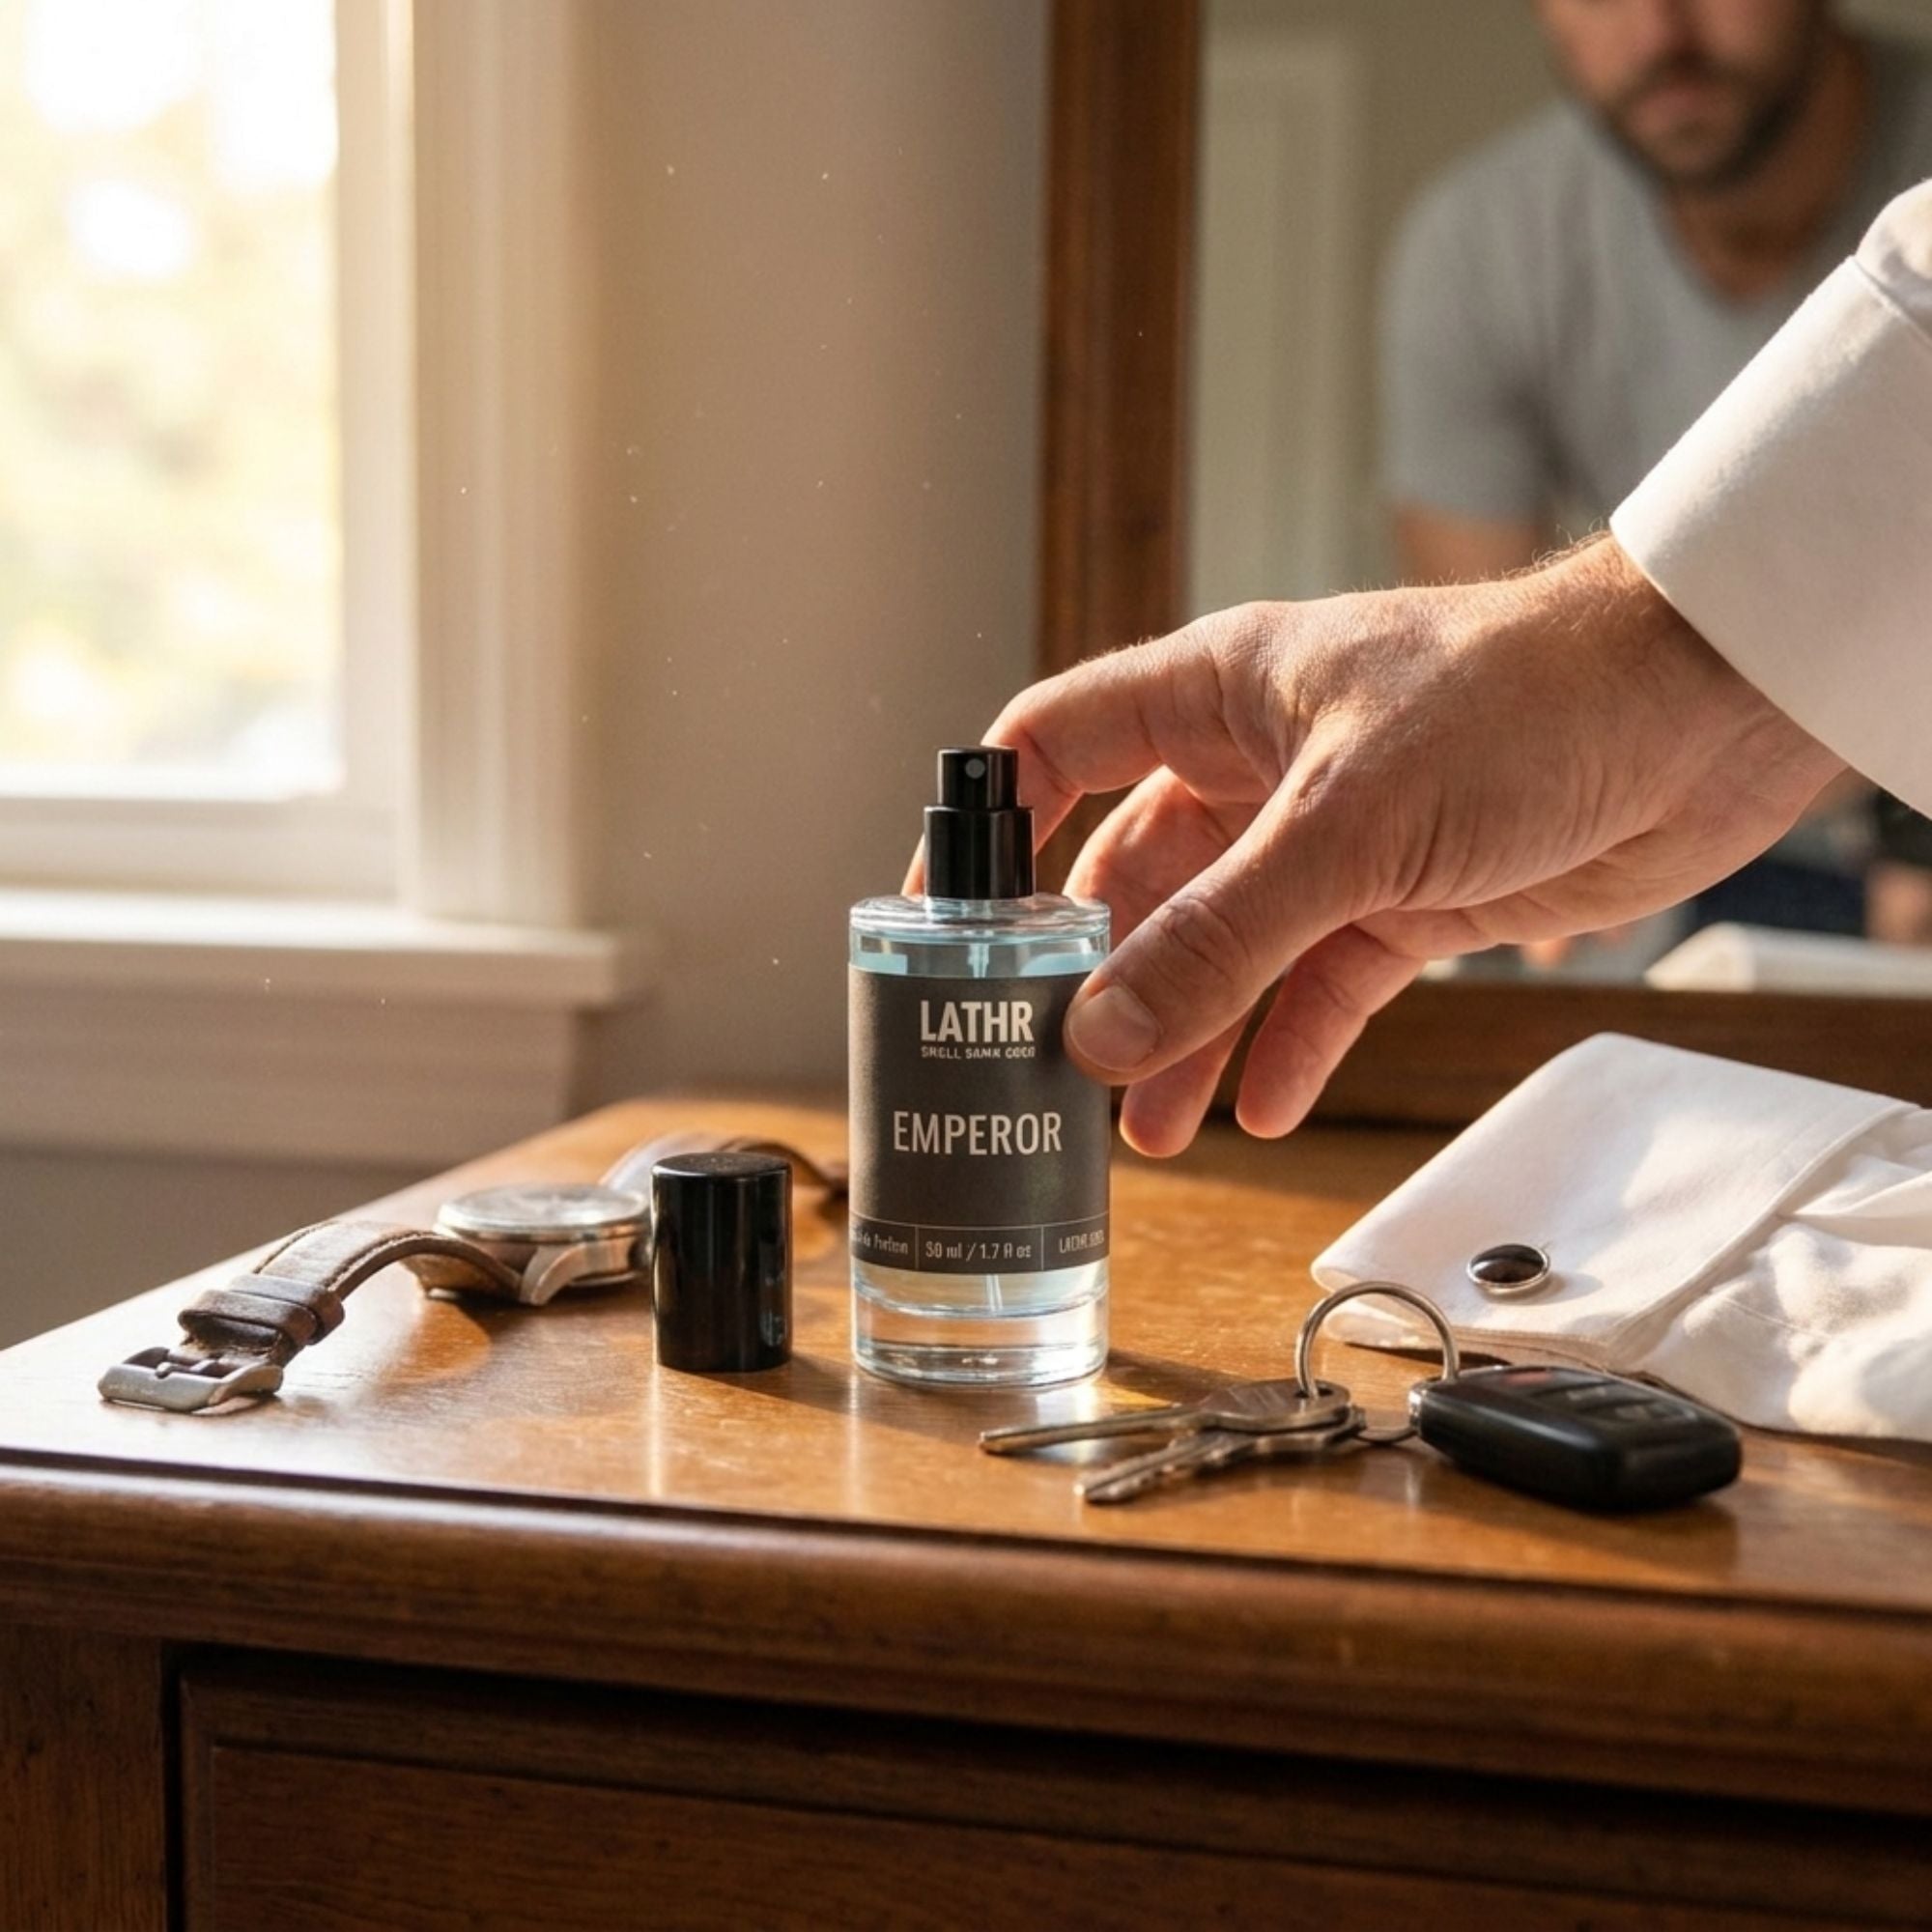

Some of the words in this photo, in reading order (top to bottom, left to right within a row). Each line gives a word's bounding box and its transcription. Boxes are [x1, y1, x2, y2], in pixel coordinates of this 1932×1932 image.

[921, 1000, 1035, 1043] LATHR
[893, 1111, 1064, 1156] EMPEROR
[979, 1242, 1000, 1260] 1.7
